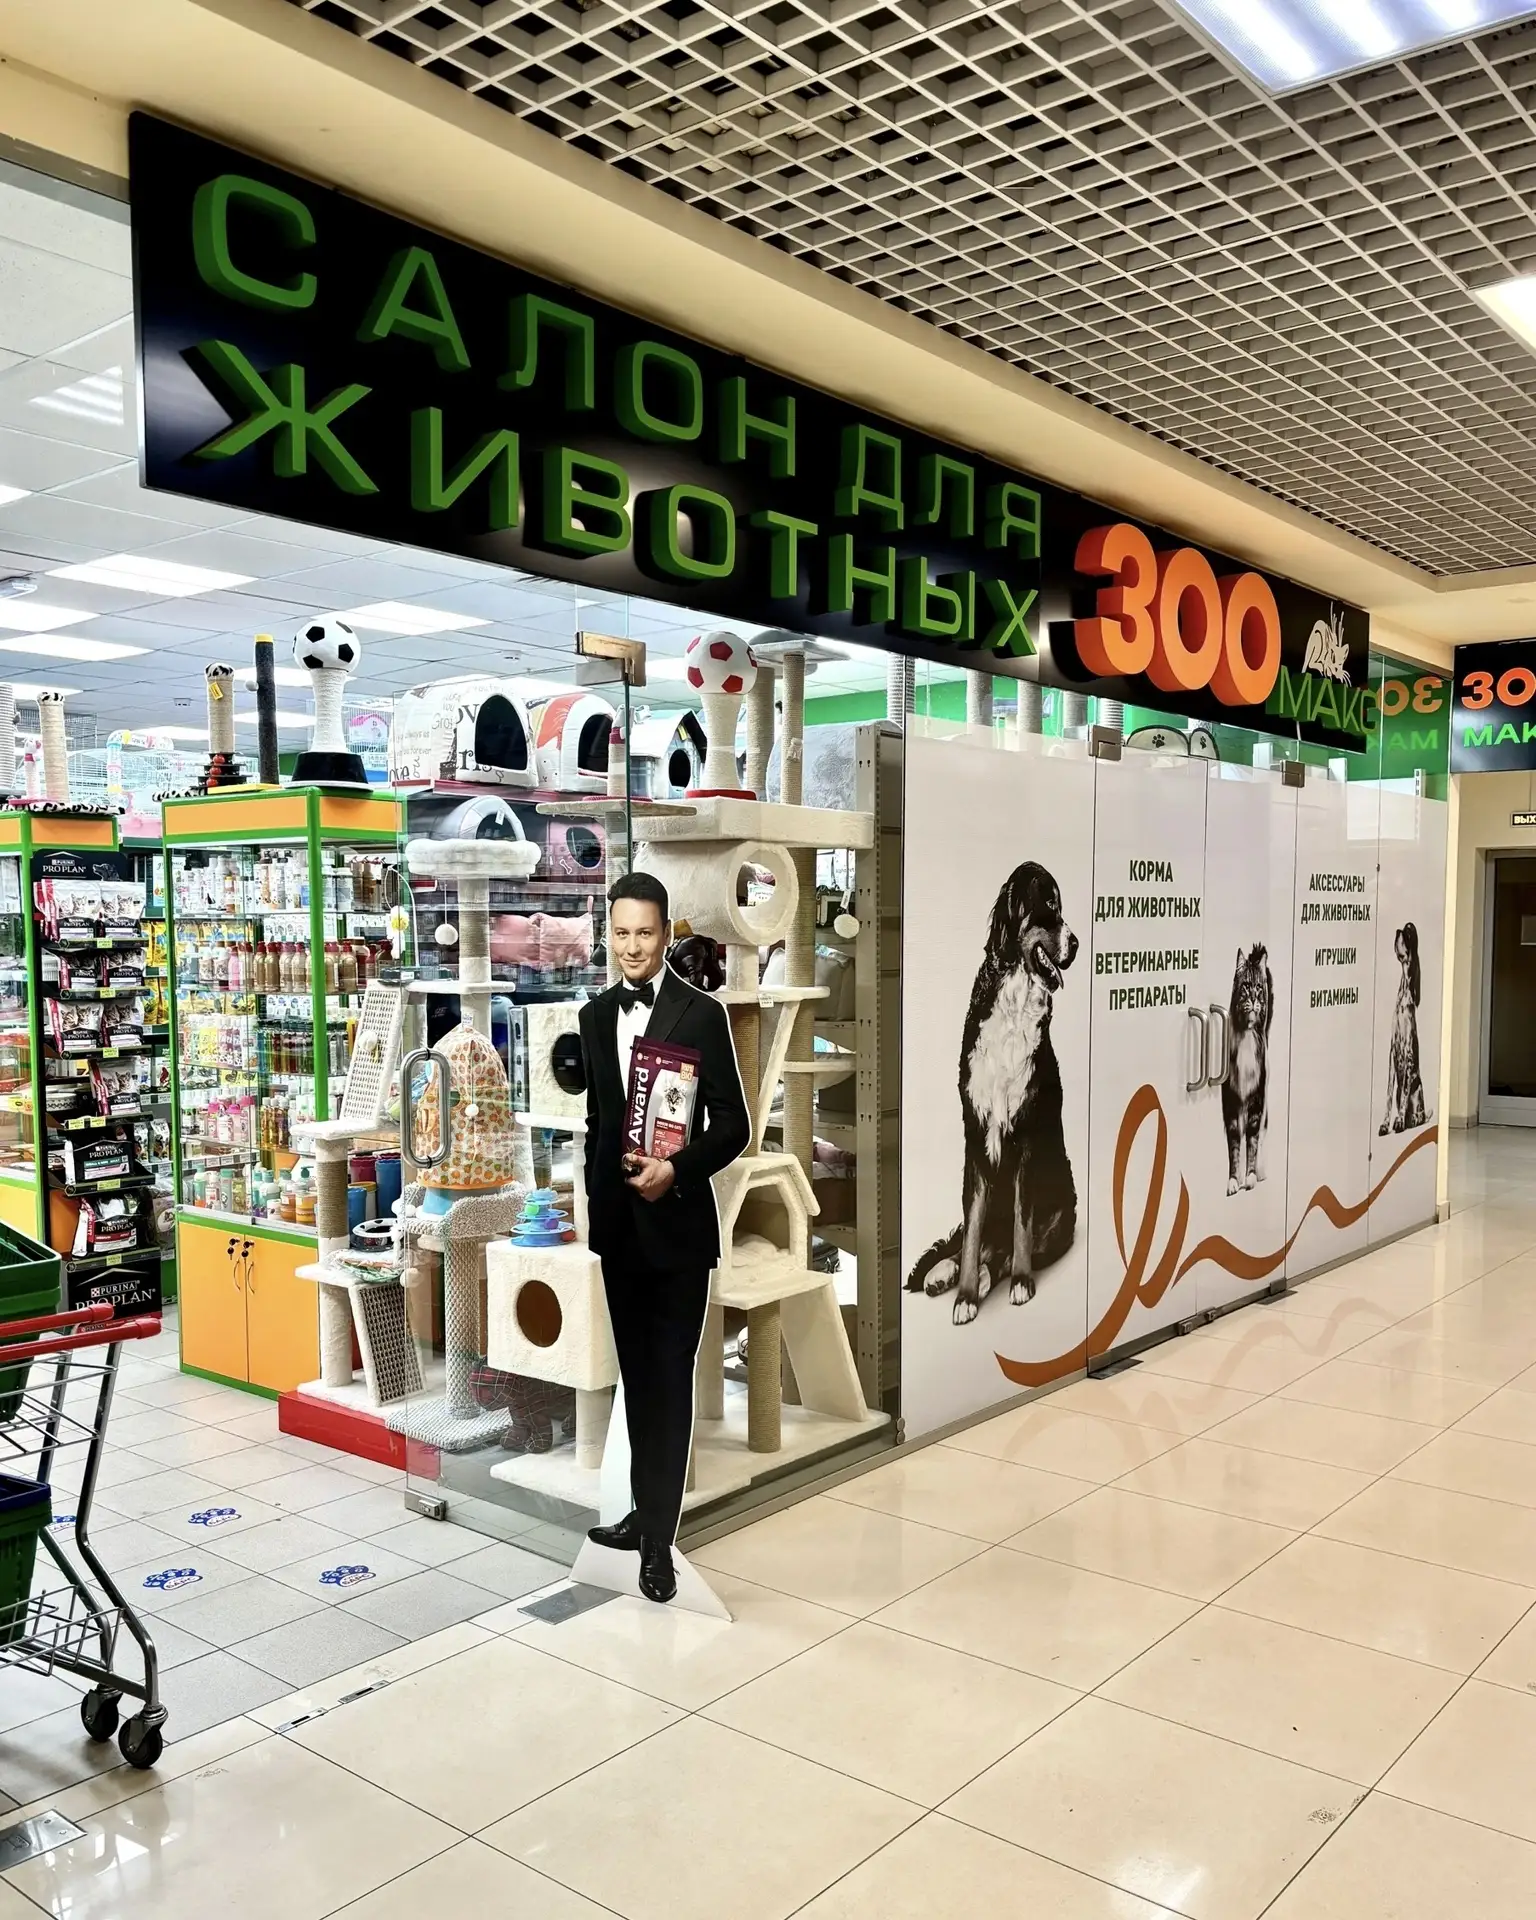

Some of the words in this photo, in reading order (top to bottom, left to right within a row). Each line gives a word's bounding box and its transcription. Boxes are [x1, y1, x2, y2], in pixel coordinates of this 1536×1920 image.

[192, 174, 795, 478] САЛОН
[834, 423, 1041, 559] ДЛЯ
[192, 339, 1038, 659] ЖИВОТНЫХ
[1074, 523, 1282, 706] ЗОО
[42, 865, 61, 873] PRO
[1129, 860, 1173, 882] КОРМА
[1309, 873, 1365, 893] АКСЕССУАРЫ
[1095, 896, 1125, 922] ДЛЯ
[1127, 897, 1201, 918] ЖИВОТНЫХ
[1301, 903, 1321, 924] ДЛЯ
[1321, 903, 1371, 922] ЖИВОТНЫХ
[1095, 949, 1199, 975] ВЕТЕРИНАРНЫЕ
[1315, 947, 1357, 966] ИГРУШКИ
[1109, 984, 1186, 1010] ПРЕПАРАТЫ
[1310, 987, 1359, 1008] ВИТАМИНЫ
[628, 1067, 650, 1146] Award
[105, 1147, 123, 1156] PLAN
[117, 1221, 134, 1230] PLAN
[101, 1283, 135, 1294] PURINA
[112, 1288, 153, 1307] PLAN
